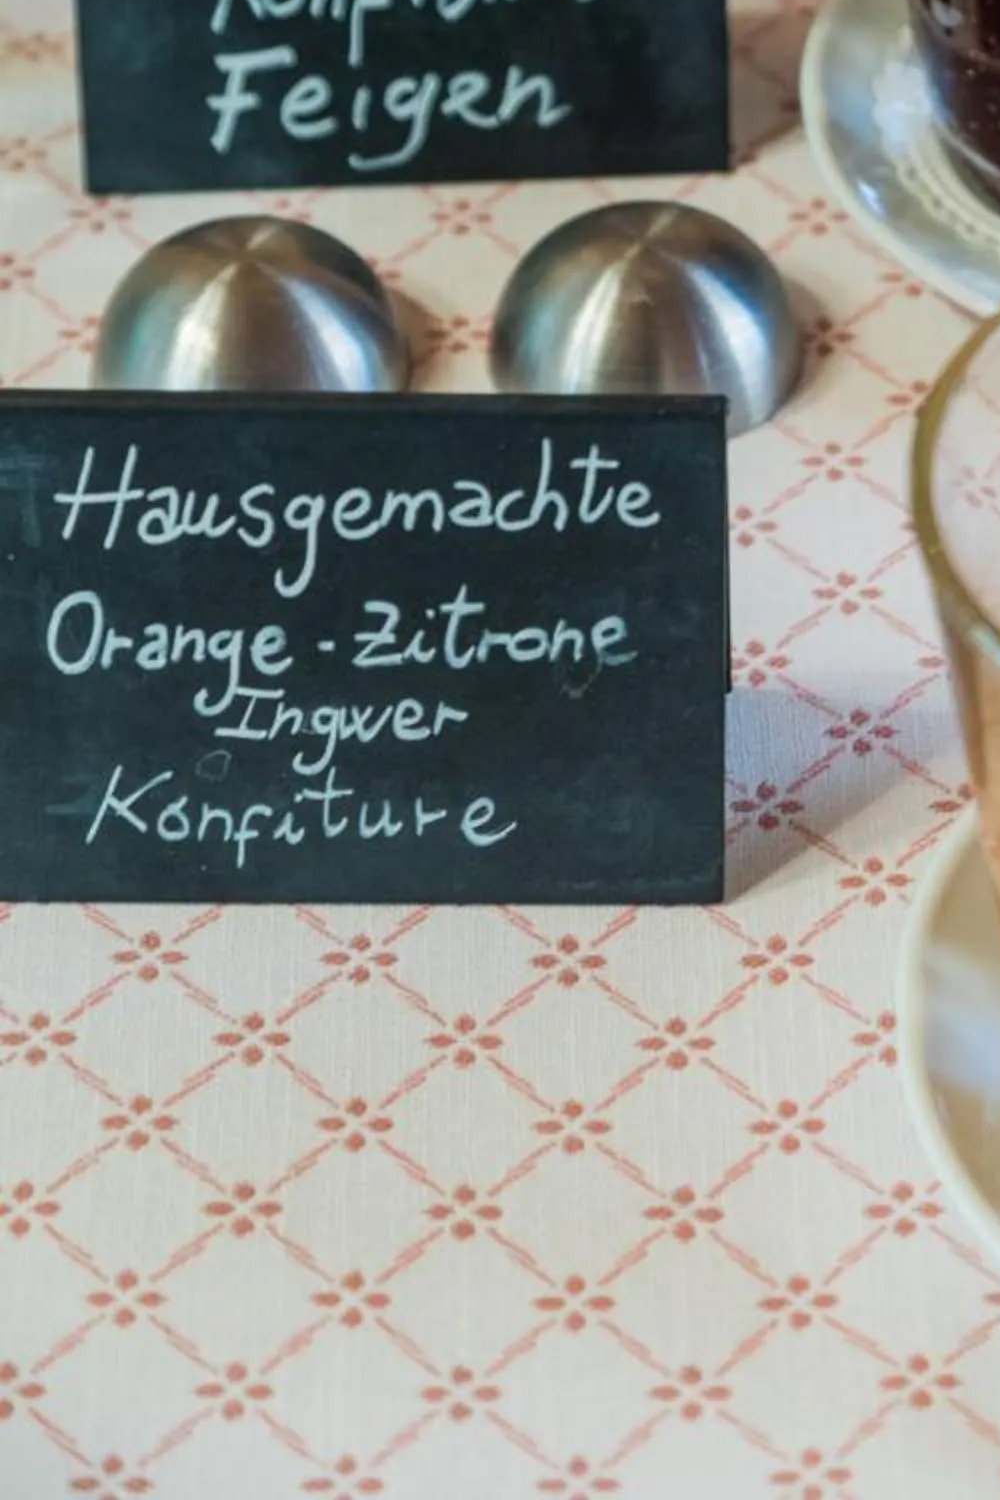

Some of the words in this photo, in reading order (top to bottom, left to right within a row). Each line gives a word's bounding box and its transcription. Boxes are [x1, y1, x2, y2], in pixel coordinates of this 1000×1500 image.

[206, 45, 572, 171] Feigen
[53, 437, 661, 598] Hausgemachte
[213, 686, 469, 776] Ingwer
[85, 764, 518, 869] Konfiture
